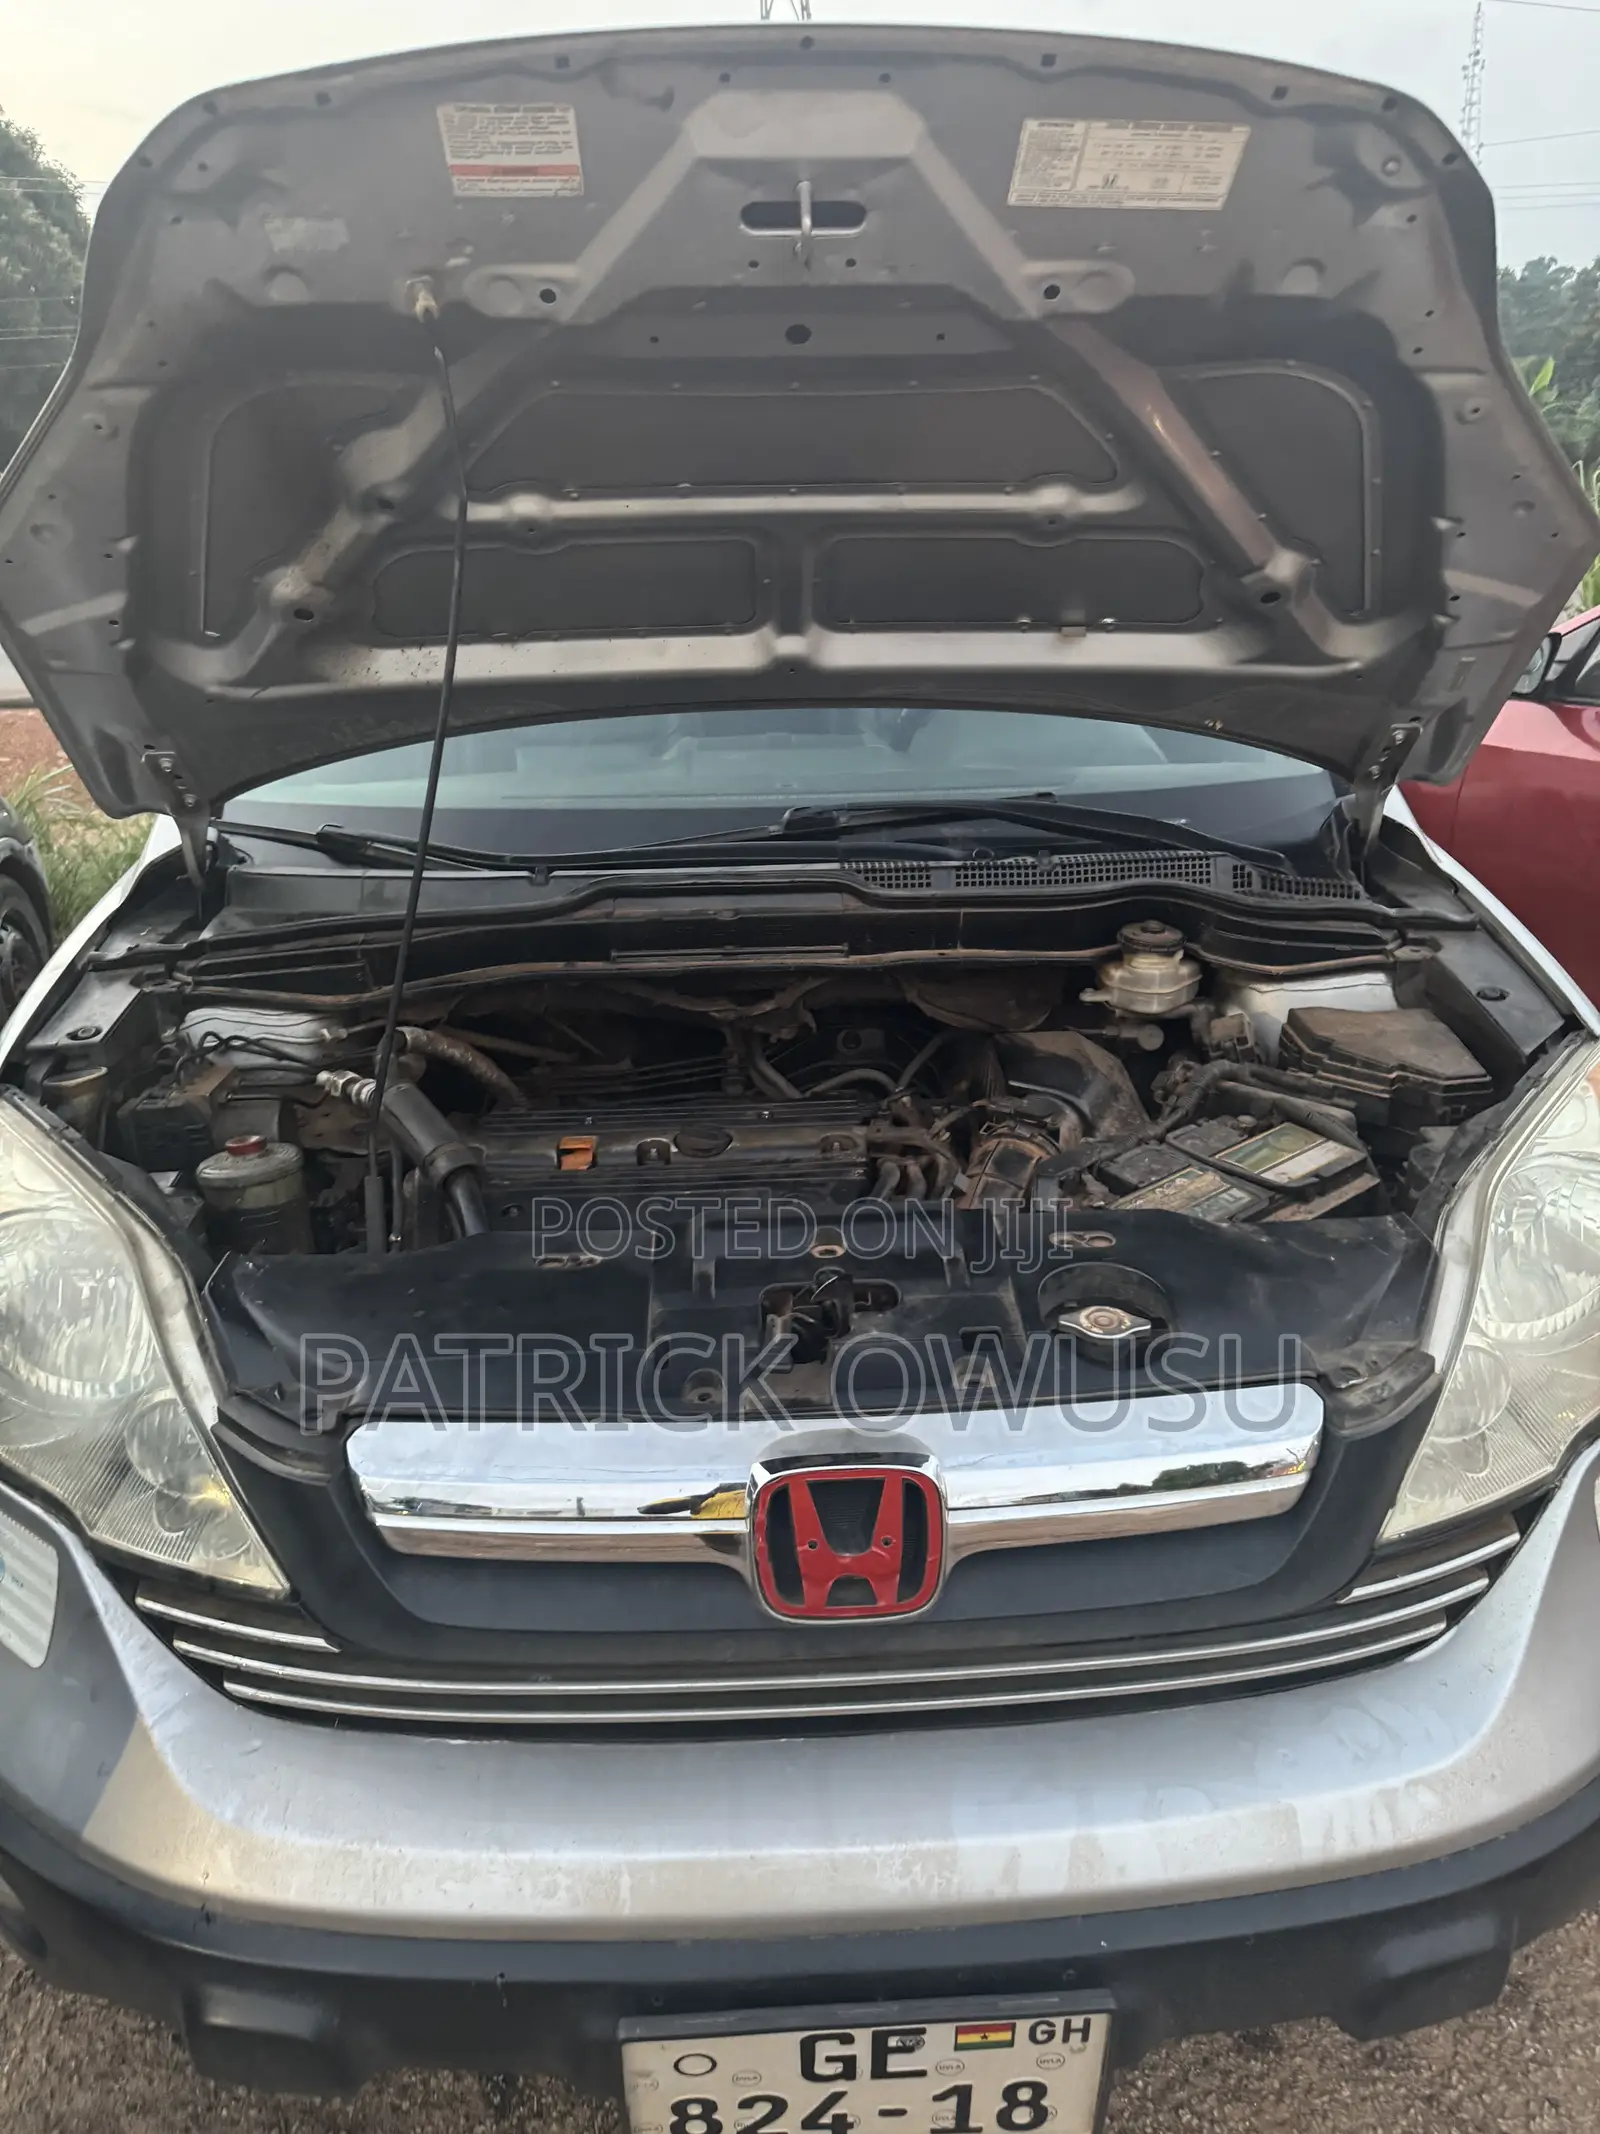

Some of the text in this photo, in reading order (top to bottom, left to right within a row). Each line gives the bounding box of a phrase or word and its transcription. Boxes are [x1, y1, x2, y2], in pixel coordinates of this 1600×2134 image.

[800, 2026, 927, 2083] GE
[1028, 2017, 1091, 2045] GH
[669, 2080, 1049, 2134] 824-18
